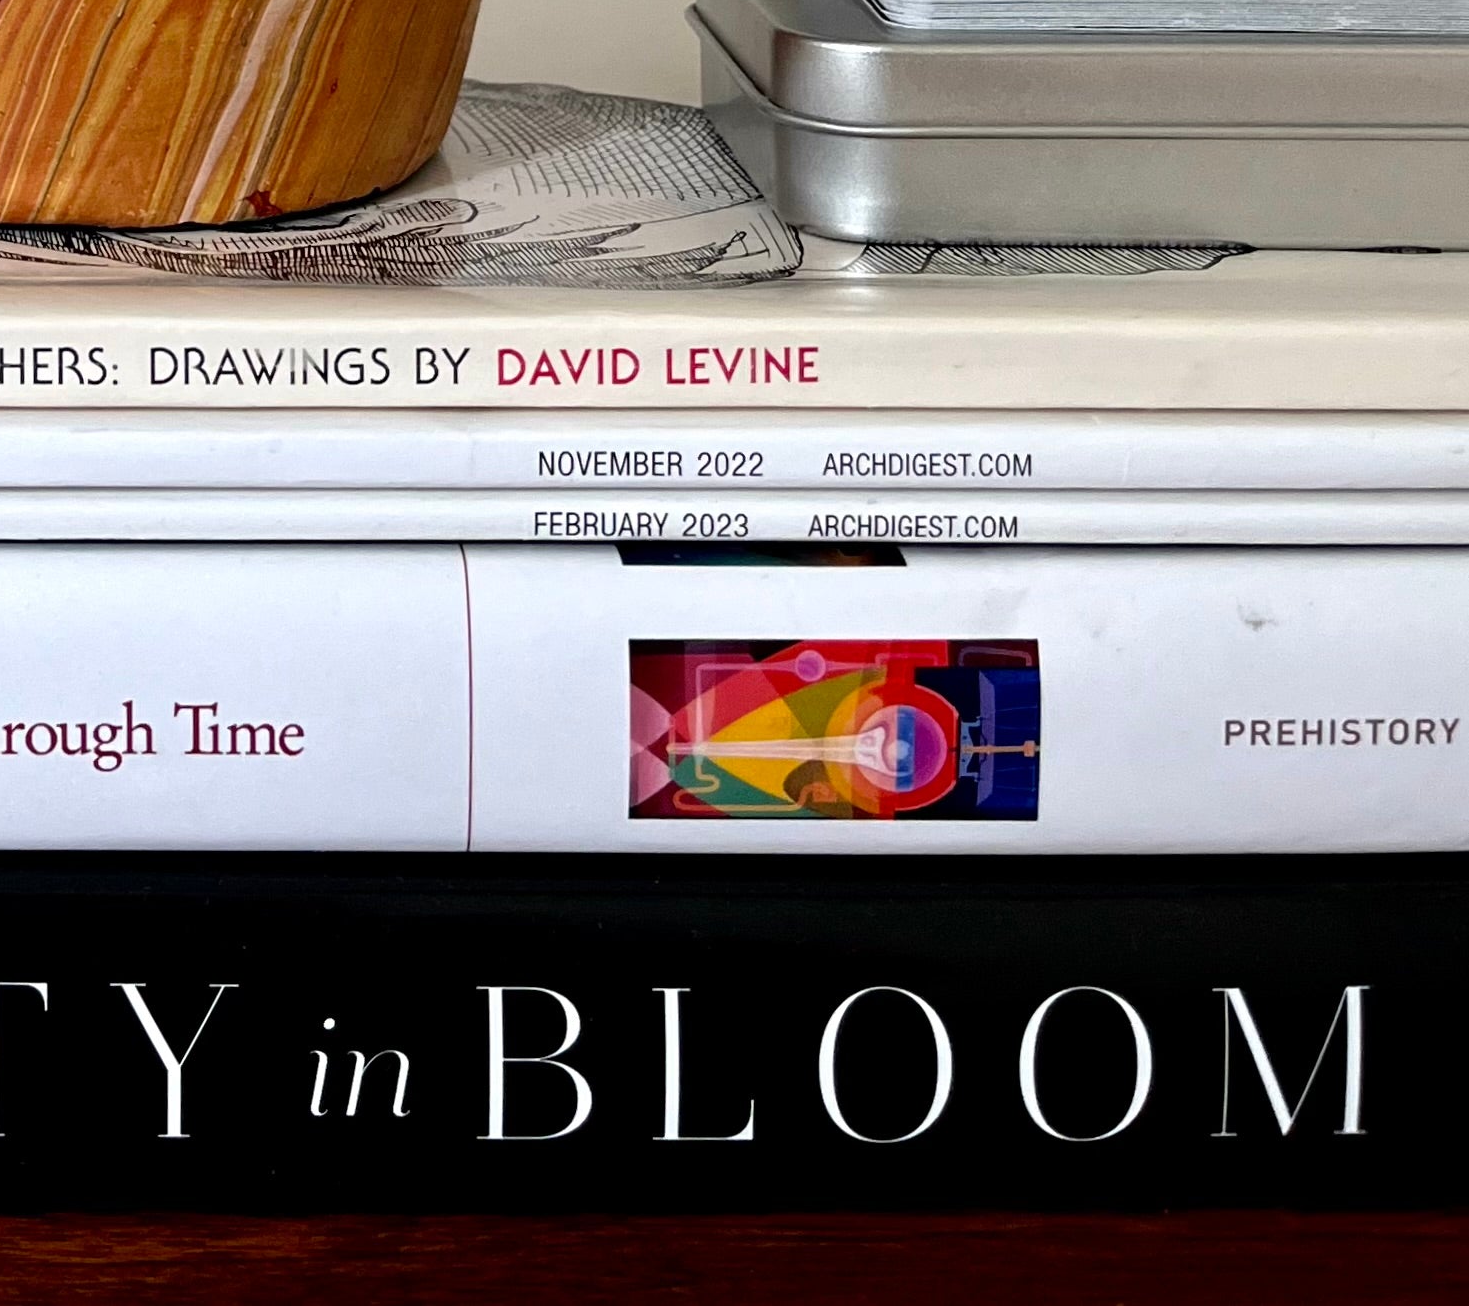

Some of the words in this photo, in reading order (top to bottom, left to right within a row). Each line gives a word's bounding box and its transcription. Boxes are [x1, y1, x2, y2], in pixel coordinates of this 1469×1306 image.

[150, 346, 391, 386] DRAWINGS
[416, 346, 469, 385] BY
[497, 347, 639, 386] DAVID
[666, 346, 819, 385] LEVINE
[538, 450, 683, 478] NOVEMBER
[697, 450, 764, 478] 2022
[822, 452, 1033, 479] ARCHDIGEST.COM
[533, 511, 668, 539] FEBRUARY
[682, 511, 750, 539] 2023
[808, 513, 1019, 540] ARCHDIGEST.COM
[173, 701, 306, 756] Time
[1223, 718, 1462, 749] PREHISTORY
[309, 1017, 412, 1118] in
[476, 985, 1371, 1144] BLOOM
